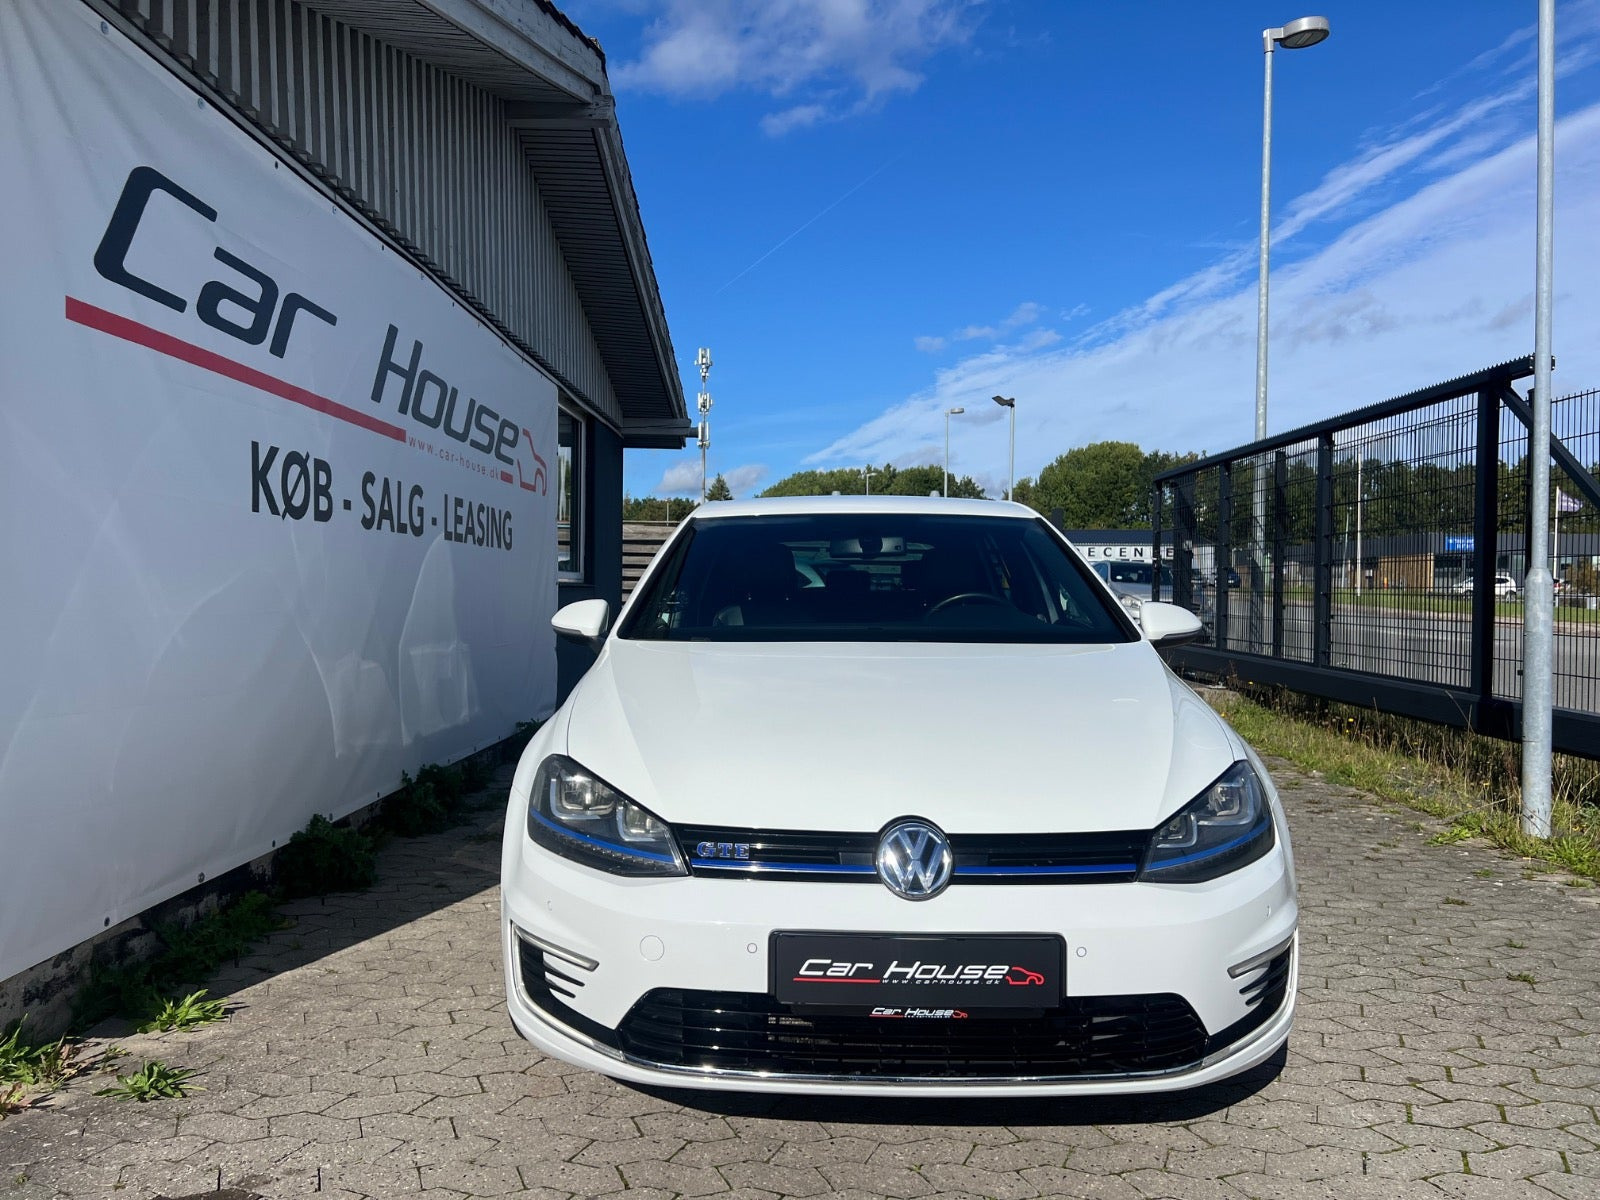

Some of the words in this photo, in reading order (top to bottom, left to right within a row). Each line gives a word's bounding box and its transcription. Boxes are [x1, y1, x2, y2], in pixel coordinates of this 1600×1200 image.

[94, 166, 337, 358] Car
[371, 324, 520, 466] House
[408, 436, 499, 480] www.car-house.dk
[251, 440, 333, 522] KØB
[361, 471, 424, 538] SALG
[444, 493, 513, 552] LEASING
[1076, 547, 1174, 557] ECENE
[696, 841, 750, 859] GTE
[799, 959, 873, 976] Car
[883, 961, 1010, 979] House
[872, 1007, 901, 1015] Car
[904, 1008, 954, 1016] House
